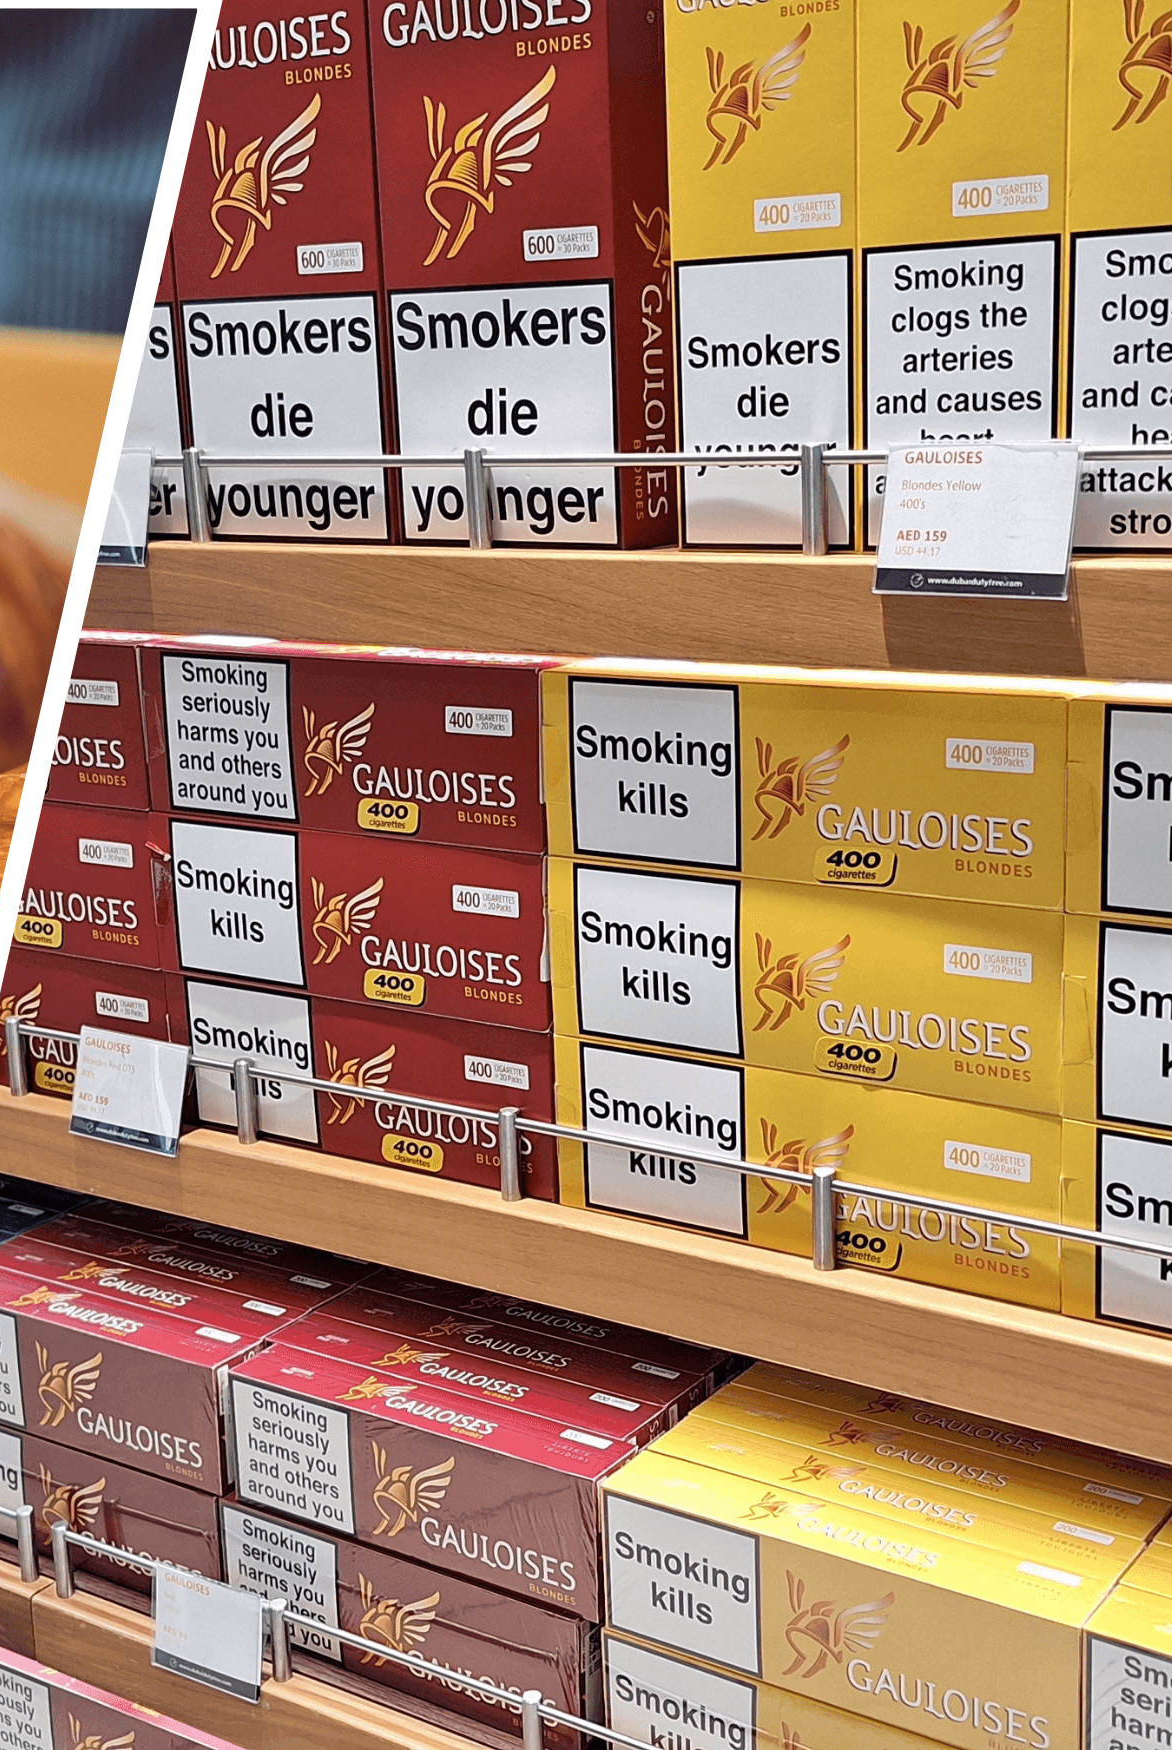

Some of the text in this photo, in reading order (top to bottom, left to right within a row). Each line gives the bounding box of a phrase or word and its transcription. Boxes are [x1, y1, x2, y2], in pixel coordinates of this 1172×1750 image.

[780, 0, 840, 17] BLONDES
[516, 33, 592, 58] BLONDES
[285, 63, 352, 85] BLONDES
[958, 181, 1043, 210] 400 CIGARETTES
[1015, 192, 1038, 206] Packs
[759, 199, 836, 226] 400 CIGARETTES
[810, 209, 832, 222] Packs
[527, 231, 594, 255] 600 CIGARETTES
[301, 250, 325, 269] 600
[893, 259, 1025, 292] Smoking
[189, 309, 371, 358] Smokers
[396, 299, 607, 351] Smokers
[891, 301, 1028, 338] clogs the
[687, 334, 841, 371] Smokers
[902, 345, 1014, 375] arteries
[737, 385, 790, 418] die
[875, 387, 1043, 416] and causes
[1082, 380, 1139, 408] and
[251, 392, 314, 438] die
[467, 388, 538, 437] die
[905, 450, 983, 465] GAULOISES
[902, 479, 982, 492] Blondes Yellow
[209, 481, 375, 531] younger
[412, 483, 604, 535] yonger
[899, 498, 926, 510] 400's
[896, 530, 947, 542] AED 159
[895, 546, 941, 557] USD 44.17
[181, 660, 268, 693] Smoking
[68, 683, 87, 700] 400
[182, 694, 270, 724] seriously
[448, 711, 509, 729] 400 CIGARETTES
[177, 719, 279, 751] harms you
[178, 751, 282, 779] and others
[576, 724, 732, 778] Smoking
[950, 743, 1029, 765] 400 CIGARETTES
[1003, 756, 1025, 769] Packs
[79, 771, 127, 787] BLONDES
[352, 763, 517, 809] GAULOISES
[177, 782, 289, 811] around you
[617, 779, 689, 819] kills
[366, 802, 409, 820] 400
[368, 818, 406, 830] cigarettes
[457, 811, 517, 828] BLONDES
[816, 803, 1034, 858] GAULOISES
[82, 843, 102, 860] 400
[826, 848, 881, 870] 400
[827, 867, 877, 882] cigarettes
[955, 858, 1034, 879] BLONDES
[177, 860, 294, 910] Smoking
[455, 890, 516, 908] 400 CIGARETTES
[20, 920, 54, 936] 400
[22, 933, 52, 944] cigarettes
[92, 929, 139, 946] BLONDES
[210, 908, 265, 943] kills
[581, 910, 732, 968] Smoking
[361, 935, 523, 987] GAULOISES
[948, 950, 1027, 972] 400 CIGARETTES
[1000, 964, 1023, 978] Packs
[373, 974, 415, 992] 400
[374, 989, 412, 1002] cigarettes
[464, 986, 523, 1005] BLONDES
[621, 966, 692, 1007] kills
[99, 997, 119, 1013] 400
[193, 1017, 309, 1070] Smoking
[817, 999, 1032, 1063] GAULOISES
[85, 1036, 131, 1055] GAULOISES
[826, 1042, 881, 1065] 400
[44, 1067, 75, 1085] 400
[468, 1060, 493, 1079] 400
[827, 1059, 877, 1076] cigarettes
[954, 1059, 1032, 1083] BLONDES
[95, 1094, 109, 1106] 159
[588, 1087, 738, 1152] Smoking
[393, 1139, 433, 1159] 400
[393, 1154, 430, 1169] cigarettes
[949, 1145, 1027, 1169] 400 CIGARETTES
[628, 1150, 697, 1186] kills
[1000, 1162, 1022, 1177] Packs
[837, 1230, 887, 1254] 400
[148, 1250, 239, 1282] GAULOISES
[954, 1253, 1030, 1279] BLONDES
[98, 1273, 193, 1308] GAULOISES
[47, 1298, 144, 1335] GAULOISES
[505, 1305, 611, 1339] GAULOISES
[464, 1332, 573, 1369] GAULOISES
[419, 1361, 530, 1400] GAULOISES
[252, 1391, 328, 1433] Smoking
[384, 1395, 500, 1436] GAULOISES
[77, 1406, 203, 1469] GAULOISES
[251, 1414, 330, 1457] seriously
[913, 1412, 1049, 1454] GAULOISES
[248, 1432, 337, 1478] harms you
[874, 1443, 1010, 1490] GAULOISES
[165, 1462, 204, 1482] BLONDES
[249, 1455, 340, 1500] and others
[248, 1478, 344, 1524] around you
[838, 1479, 977, 1529] GAULOISES
[242, 1518, 316, 1563] Smoking
[1057, 1523, 1078, 1533] 200
[420, 1517, 577, 1593] GAULOISES
[798, 1515, 940, 1571] GAULOISES
[242, 1542, 318, 1586] seriously
[614, 1530, 751, 1603] Smoking
[164, 1572, 211, 1596] GAULOISES
[238, 1559, 289, 1594] harms
[293, 1584, 325, 1607] you
[529, 1582, 576, 1607] BLONDES
[651, 1580, 714, 1628] kills
[300, 1626, 332, 1652] you
[615, 1674, 746, 1750] Smoking
[846, 1657, 1052, 1750] GAULOISES
[15, 1719, 42, 1740] you
